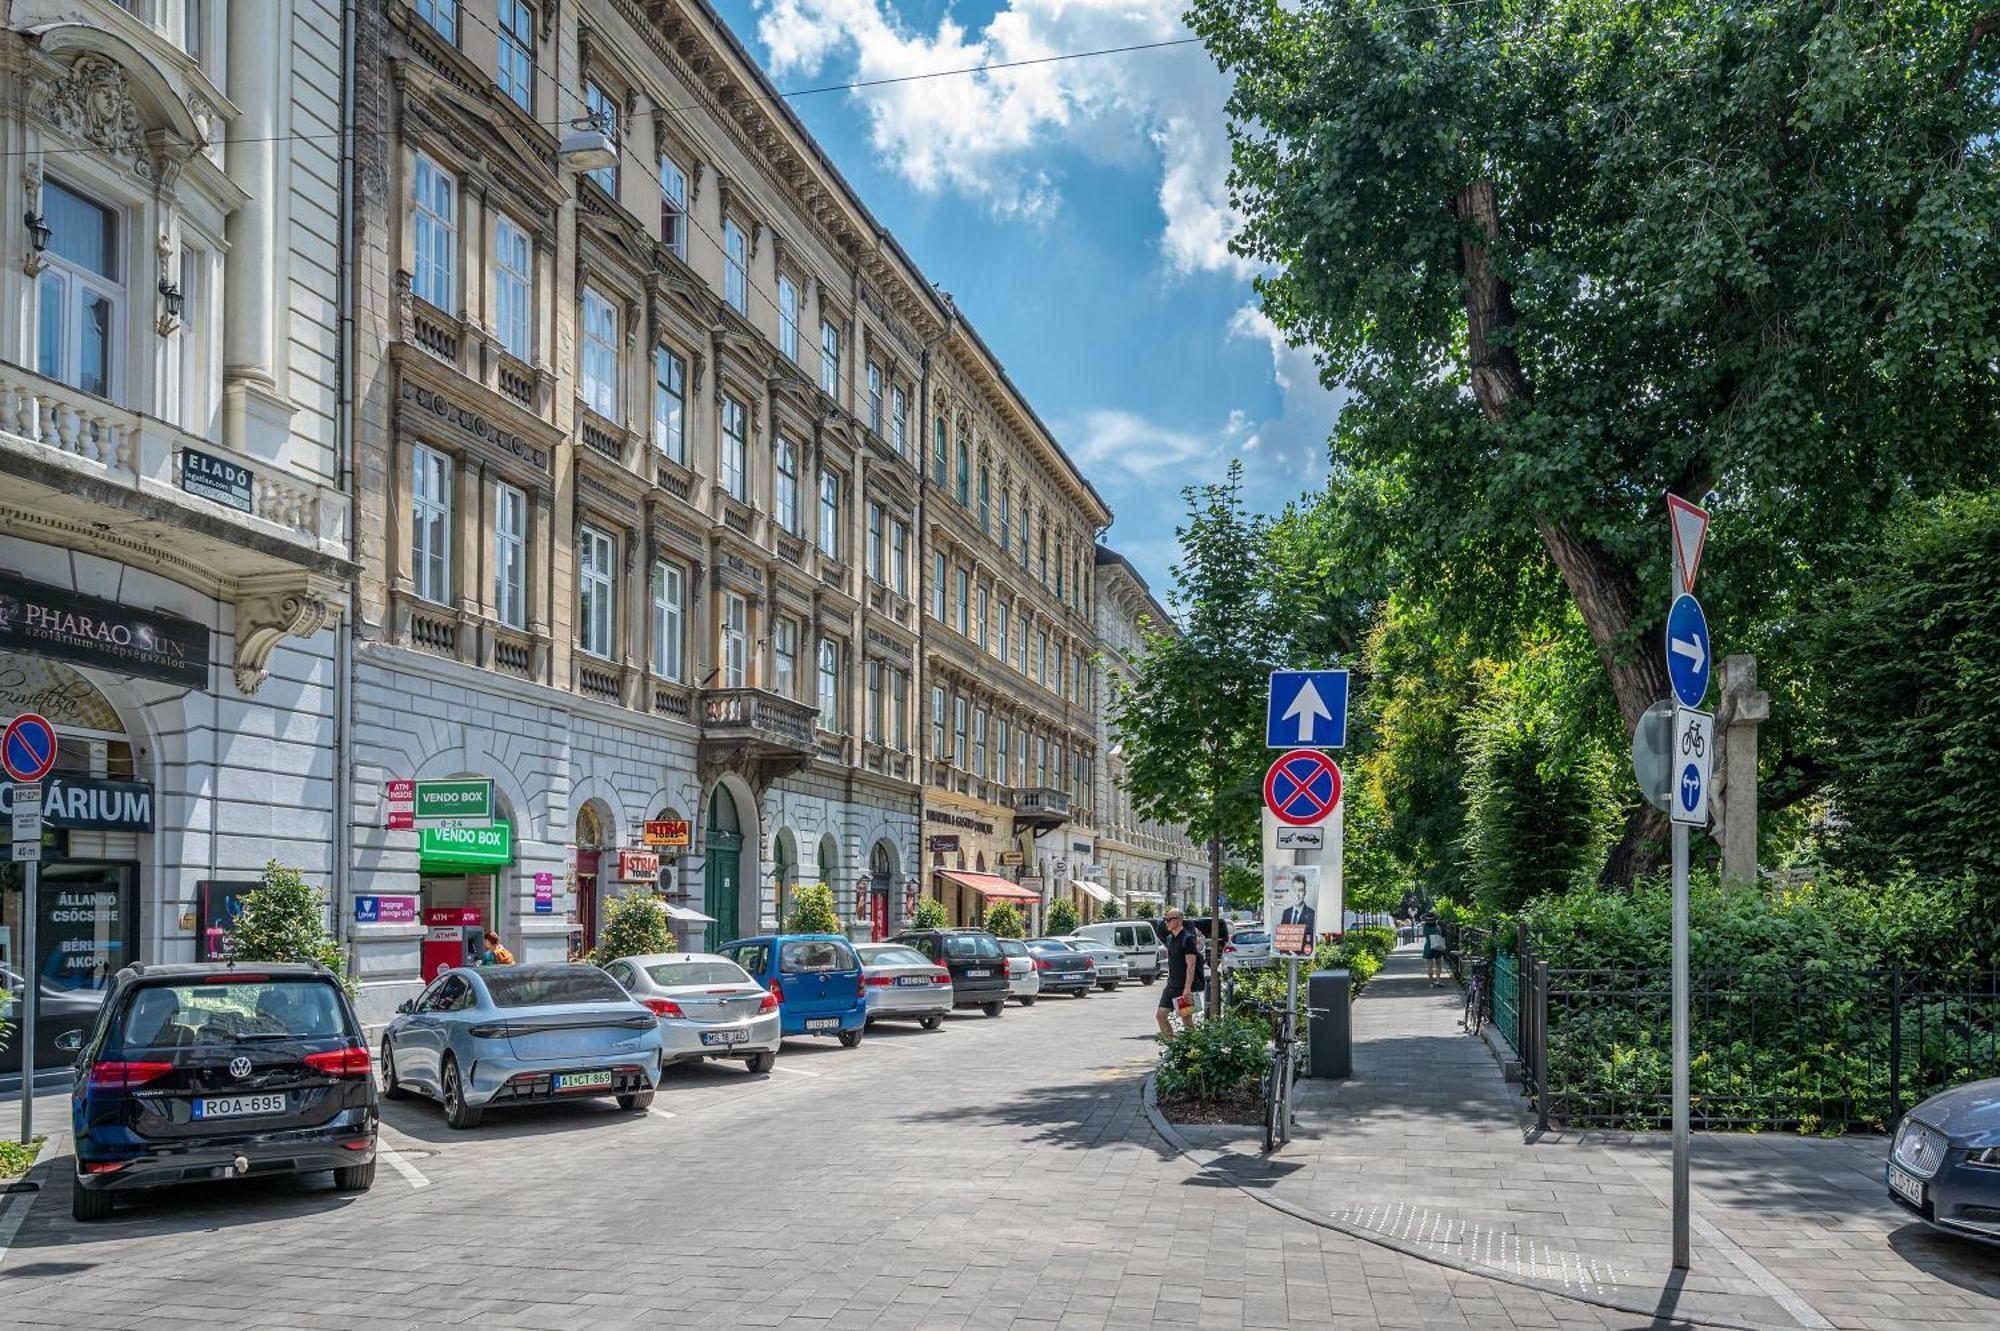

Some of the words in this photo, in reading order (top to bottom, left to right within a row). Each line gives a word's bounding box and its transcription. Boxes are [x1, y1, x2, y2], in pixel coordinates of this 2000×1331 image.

[189, 454, 247, 486] ELADÓ
[25, 604, 131, 645] PHARAO
[138, 624, 185, 658] SUN
[390, 790, 413, 799] INSIDE
[394, 783, 409, 791] ATM
[423, 793, 459, 803] VENDO
[461, 792, 483, 801] BOX
[646, 822, 687, 835] ISTRIA
[434, 828, 475, 843] VENDO
[478, 832, 501, 846] BOX
[626, 856, 657, 873] ISTRIA
[58, 891, 116, 906] ÁLLANDÓ
[206, 1096, 282, 1115] ROA-695
